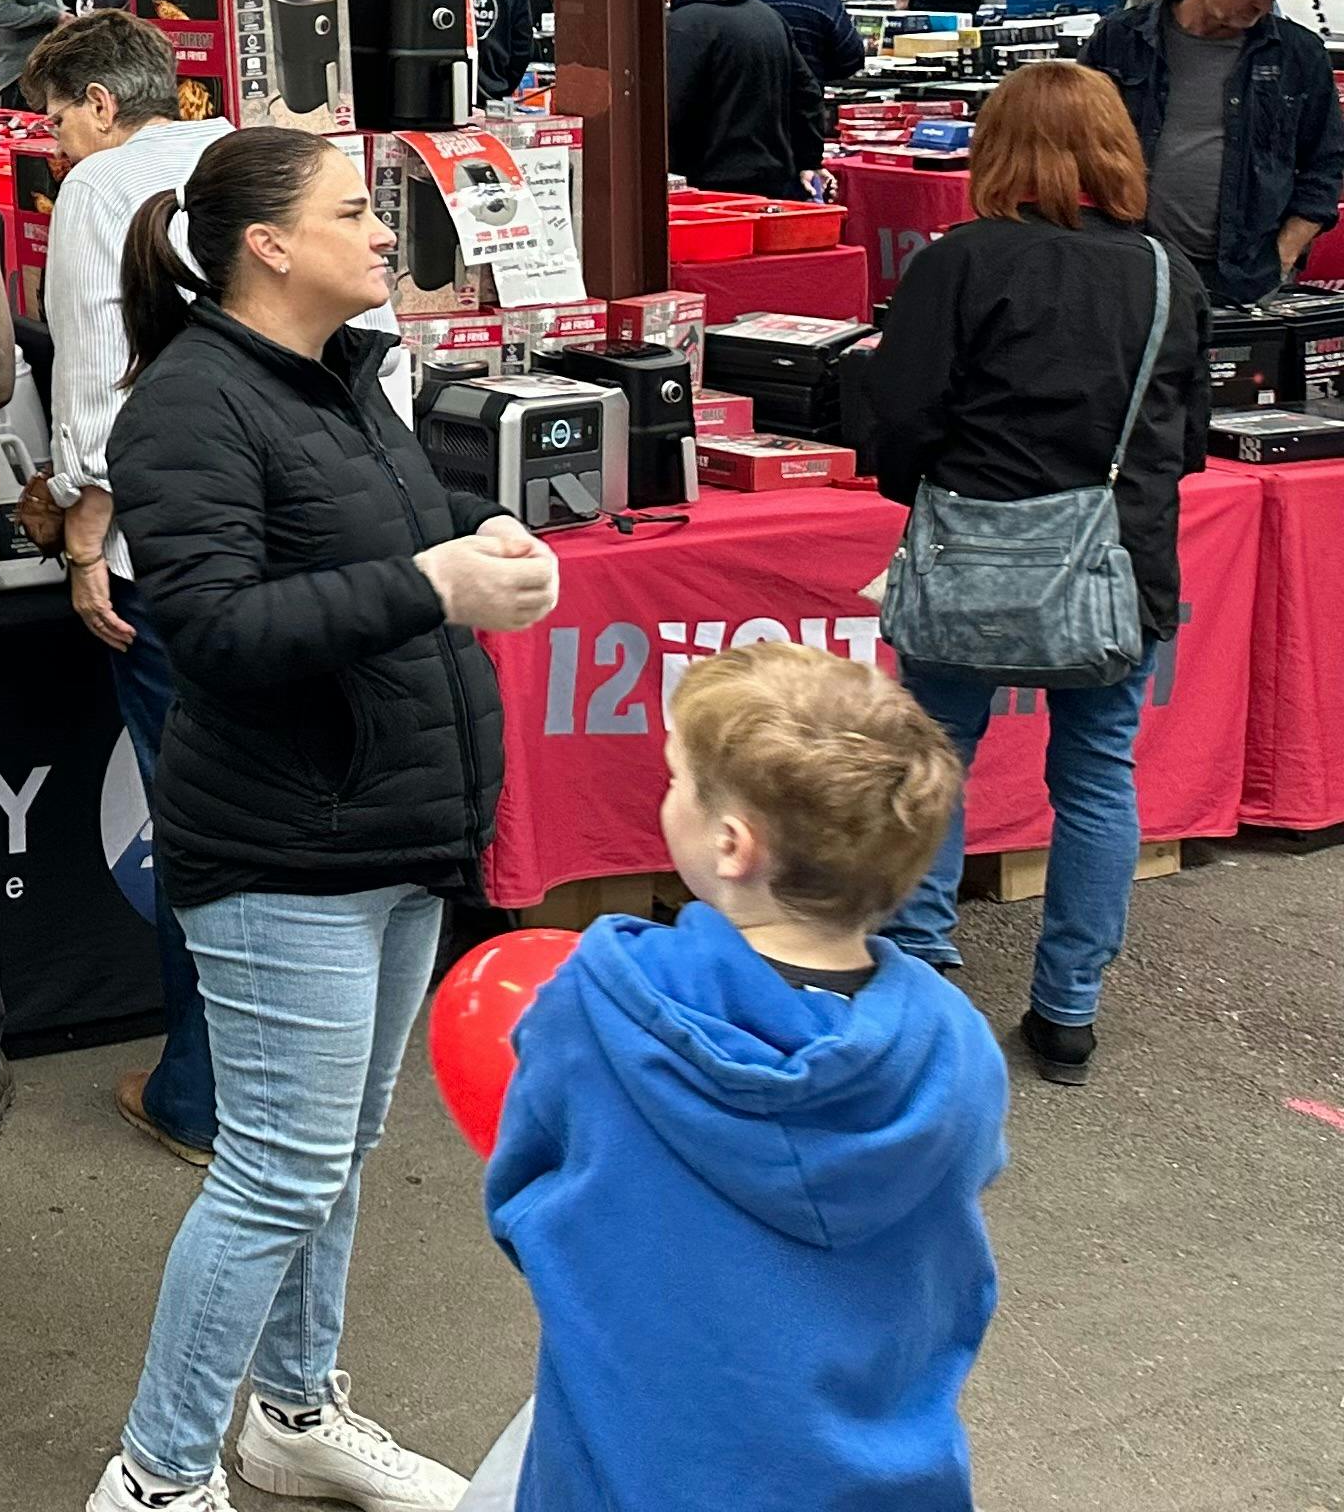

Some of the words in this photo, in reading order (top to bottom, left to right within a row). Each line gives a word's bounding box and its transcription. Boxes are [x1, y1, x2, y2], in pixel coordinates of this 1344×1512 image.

[175, 52, 186, 62] AIR
[187, 51, 208, 62] FRYER
[540, 135, 551, 145] AIR
[552, 134, 574, 144] FRYER
[440, 138, 487, 160] SPECIAL
[560, 321, 572, 331] AIR
[573, 319, 595, 330] FRYER
[453, 332, 465, 343] AIR
[466, 331, 490, 342] FRYER
